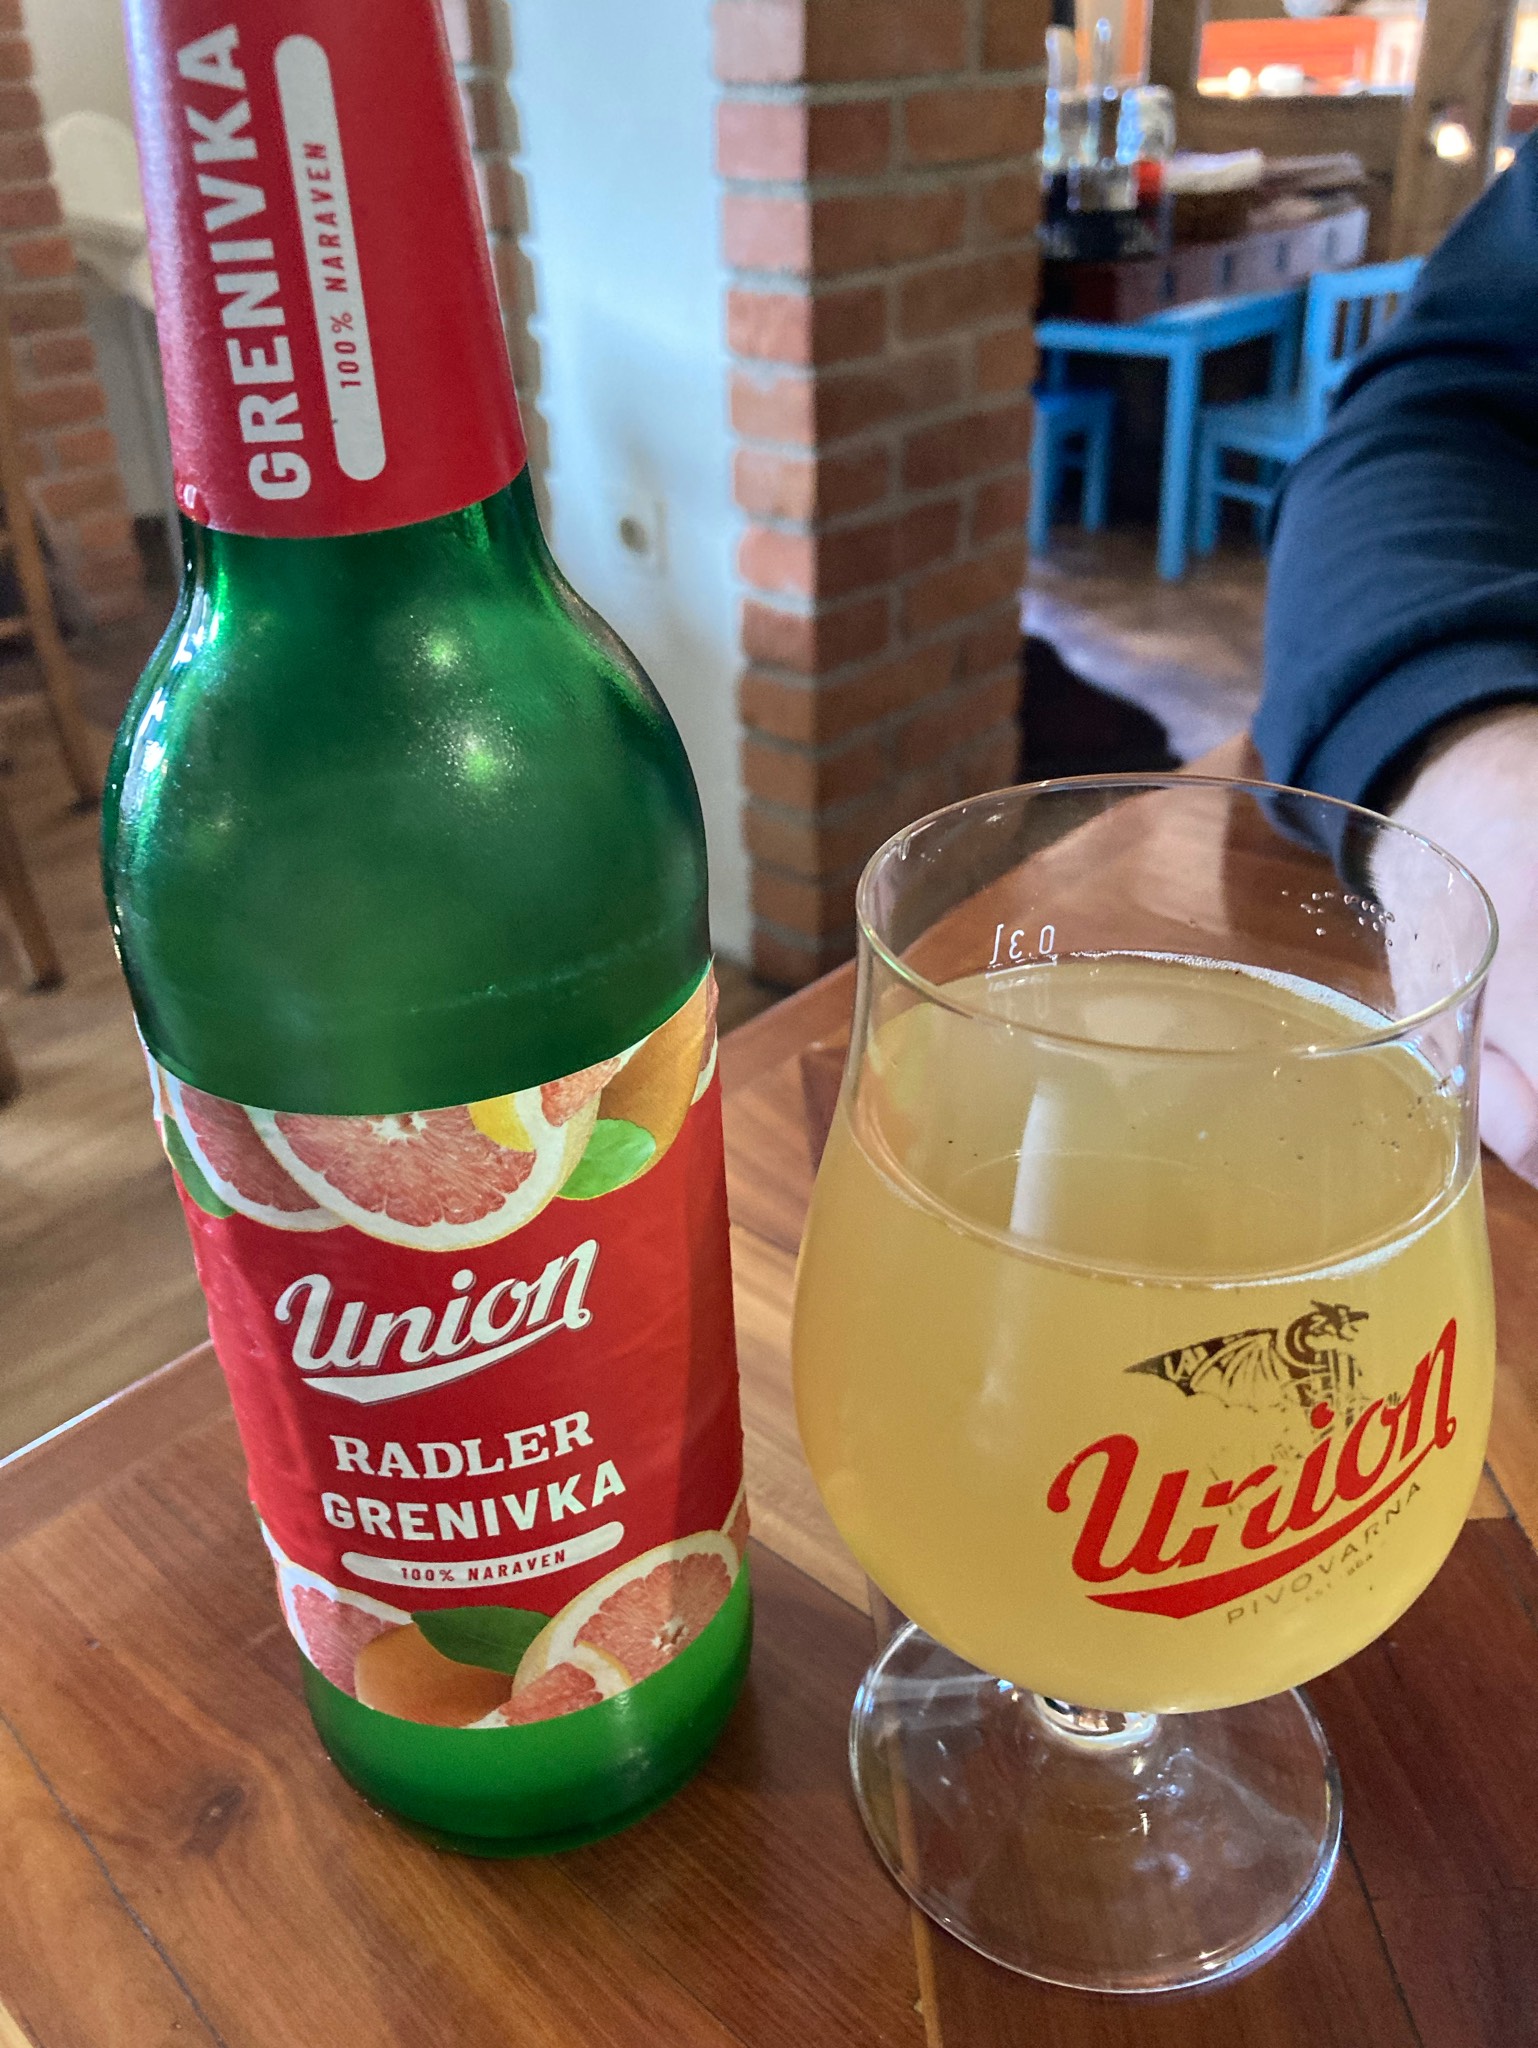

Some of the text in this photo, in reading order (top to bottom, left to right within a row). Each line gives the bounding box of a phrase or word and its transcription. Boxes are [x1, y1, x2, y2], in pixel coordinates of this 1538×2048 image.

[177, 24, 311, 500] GRENIVKA
[303, 143, 361, 388] 100% NARAVEN
[274, 1238, 599, 1404] Union
[322, 1460, 627, 1541] GRENIVKA
[330, 1410, 594, 1480] RADLER
[1047, 1317, 1457, 1619] Union
[401, 1549, 566, 1582] 100% NARAVEN
[1227, 1482, 1421, 1624] PIVOVARNA
